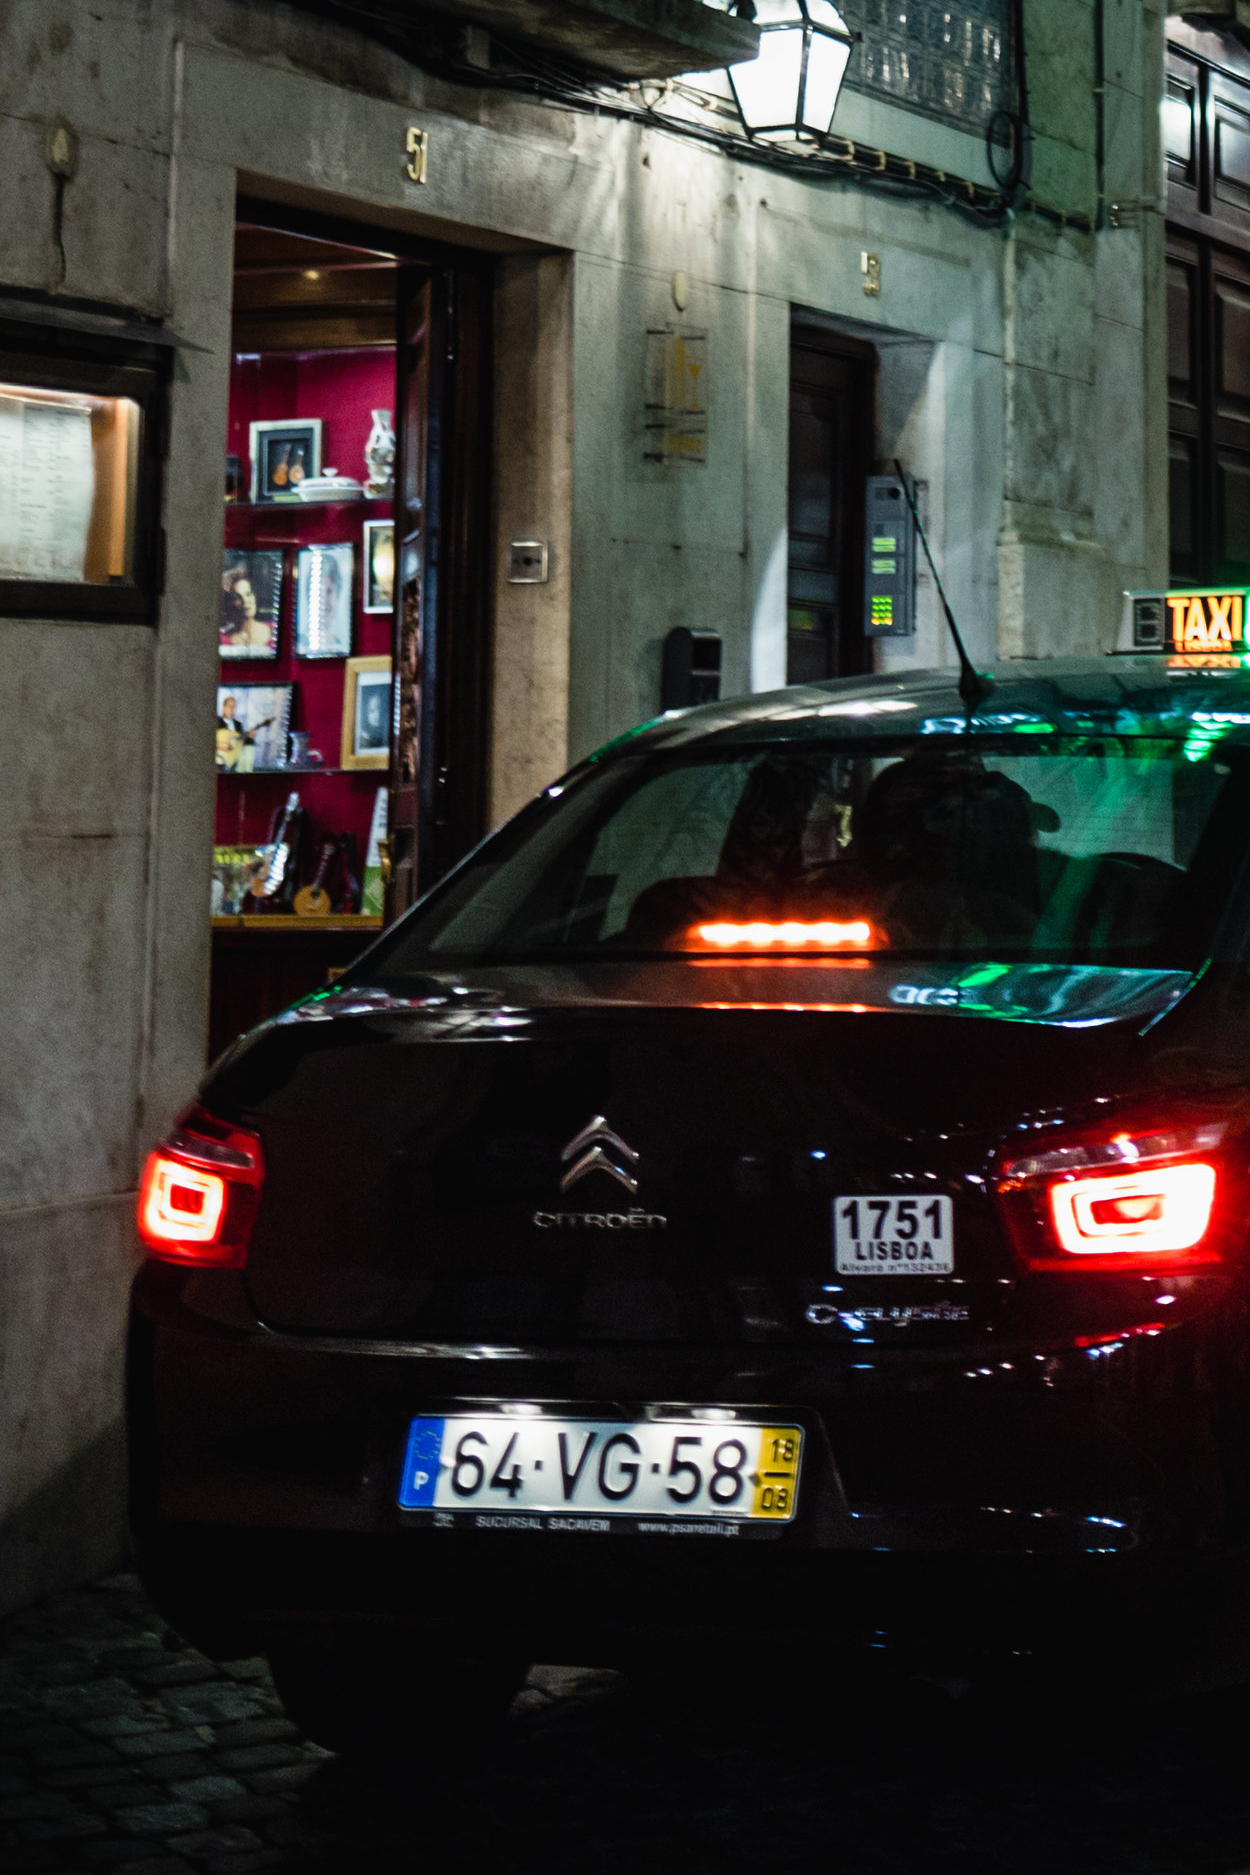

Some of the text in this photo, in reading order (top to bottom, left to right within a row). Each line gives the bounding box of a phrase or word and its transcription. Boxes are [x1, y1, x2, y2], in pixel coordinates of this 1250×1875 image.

[406, 127, 428, 184] 51
[1167, 596, 1242, 641] TAXI
[842, 1199, 942, 1240] 1751
[855, 1241, 934, 1261] LISBOA
[413, 1472, 429, 1491] P
[475, 1515, 543, 1530] SUCURSAL
